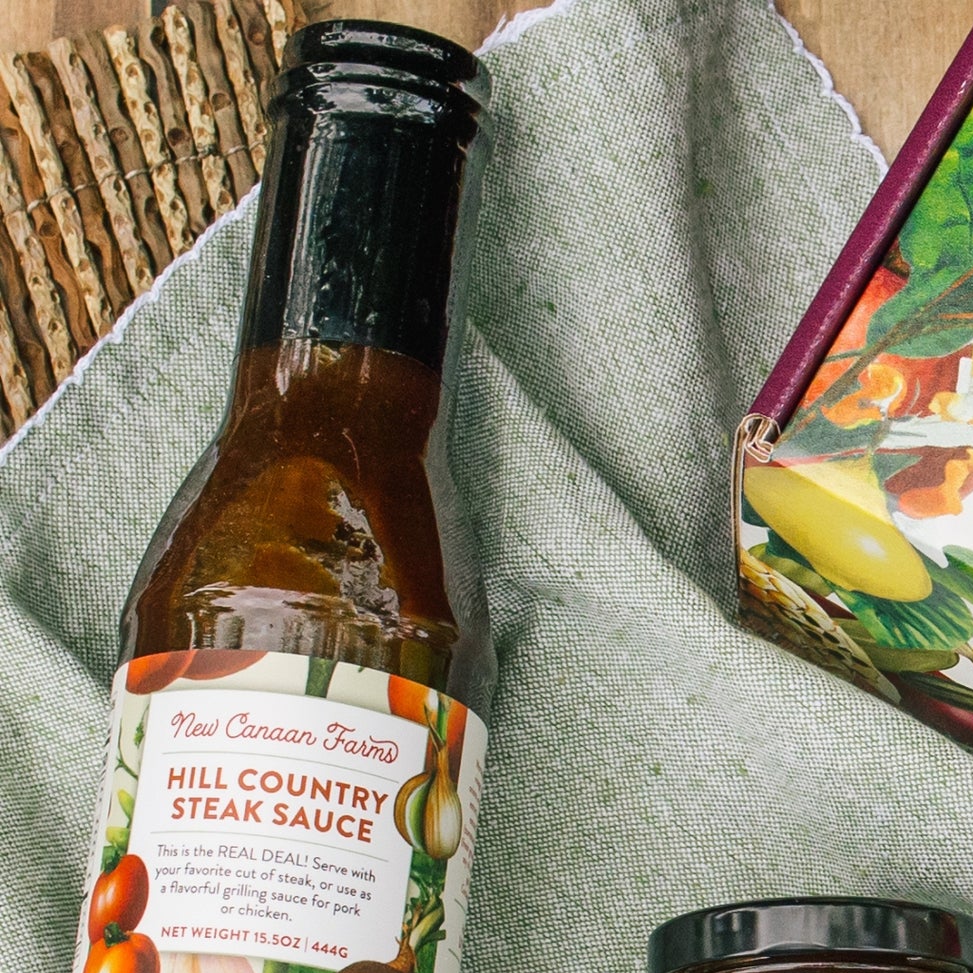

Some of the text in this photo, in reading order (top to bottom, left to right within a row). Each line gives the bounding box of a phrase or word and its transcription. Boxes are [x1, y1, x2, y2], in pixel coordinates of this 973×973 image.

[171, 711, 399, 764] New Canaan Farms
[167, 767, 389, 815] HILL COUNTRY
[171, 797, 373, 843] STEAK SAUCE
[155, 862, 372, 901] your favorite cut of steak, or use as
[157, 844, 376, 883] This is the REAL DEAL! Serve with
[160, 880, 360, 917] a flavorful grilling sauce for pork
[220, 903, 292, 922] or chicken.
[161, 926, 348, 958] NET WEIGHT 15.5OZ 444G
